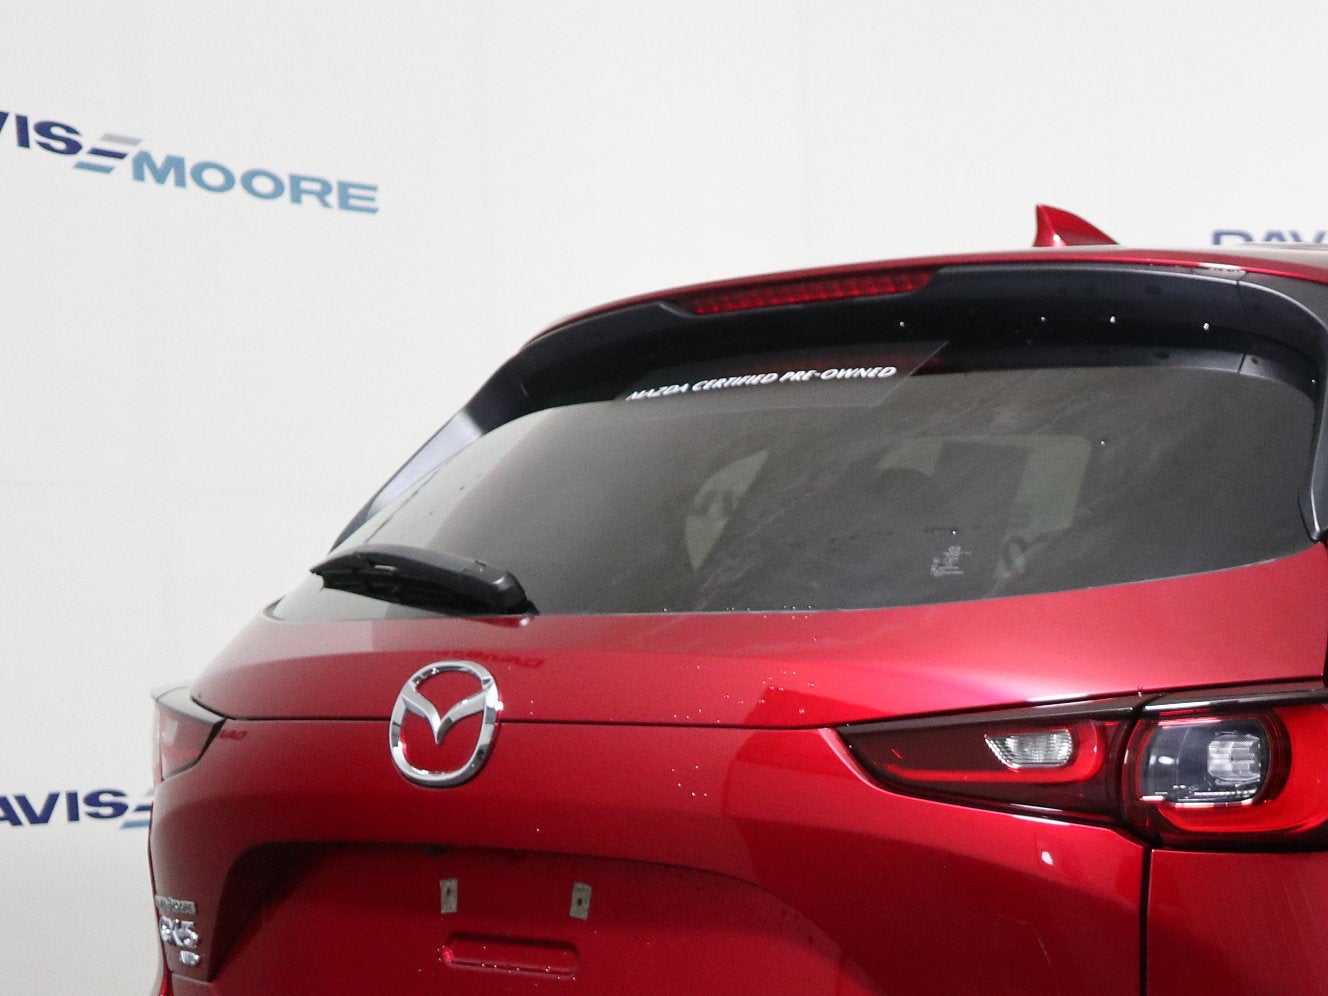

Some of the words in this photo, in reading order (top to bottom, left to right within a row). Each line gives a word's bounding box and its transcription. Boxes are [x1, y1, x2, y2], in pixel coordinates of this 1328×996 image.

[131, 150, 379, 214] MOORE
[626, 383, 687, 400] MAZDA
[692, 373, 778, 391] CERTIFIED
[779, 366, 897, 383] PRE-OWNED
